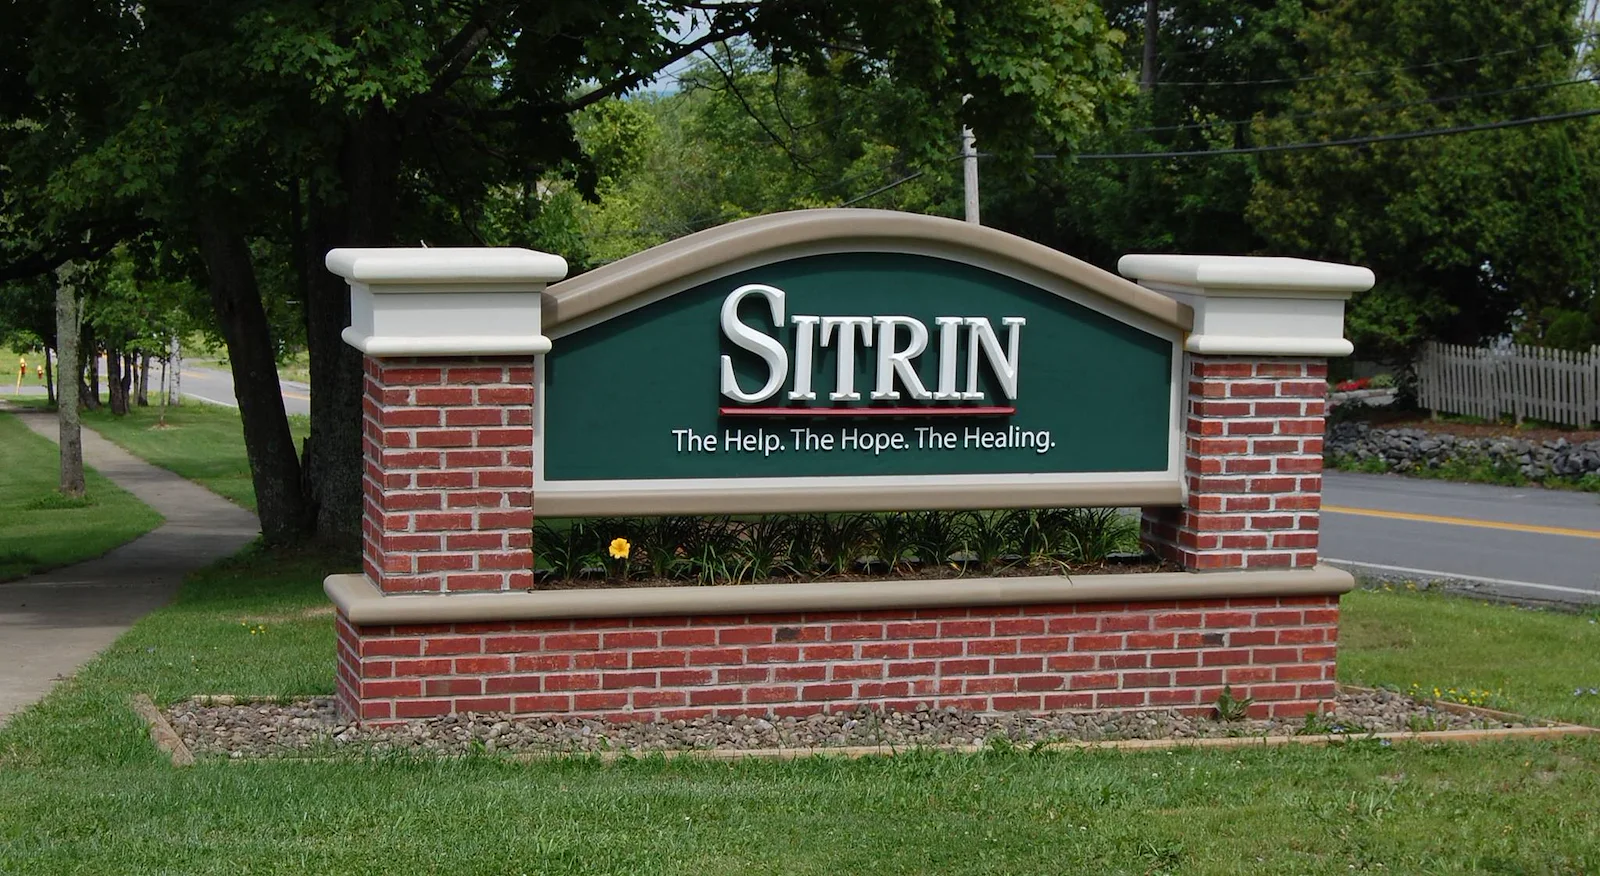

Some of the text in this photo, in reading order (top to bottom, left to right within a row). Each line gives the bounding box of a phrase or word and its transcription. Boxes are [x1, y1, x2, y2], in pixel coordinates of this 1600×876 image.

[720, 283, 1026, 403] SITRIN
[672, 425, 1056, 457] The Help. The Hope. The Healing.
